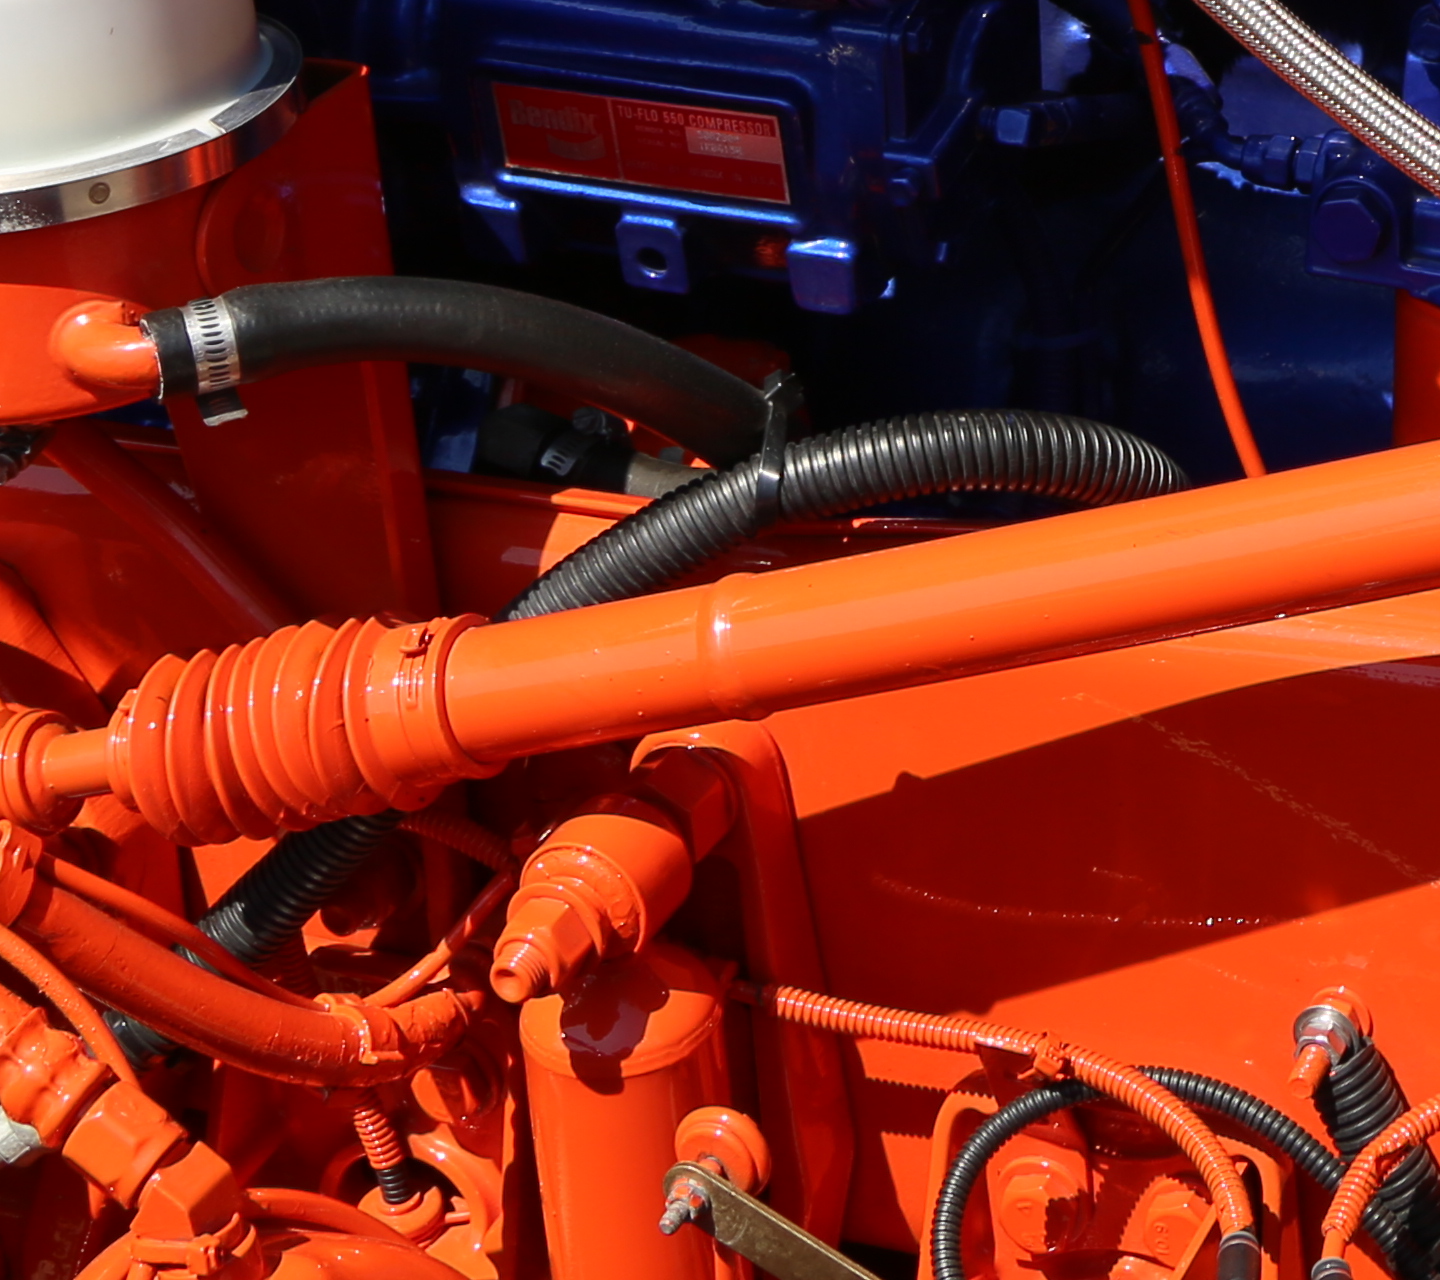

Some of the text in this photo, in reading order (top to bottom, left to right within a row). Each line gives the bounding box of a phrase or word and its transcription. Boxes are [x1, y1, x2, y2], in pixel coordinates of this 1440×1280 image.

[511, 99, 598, 135] Bendix
[616, 104, 659, 123] TU-FLO
[662, 110, 685, 126] 550
[688, 113, 772, 137] COMPRESSOR
